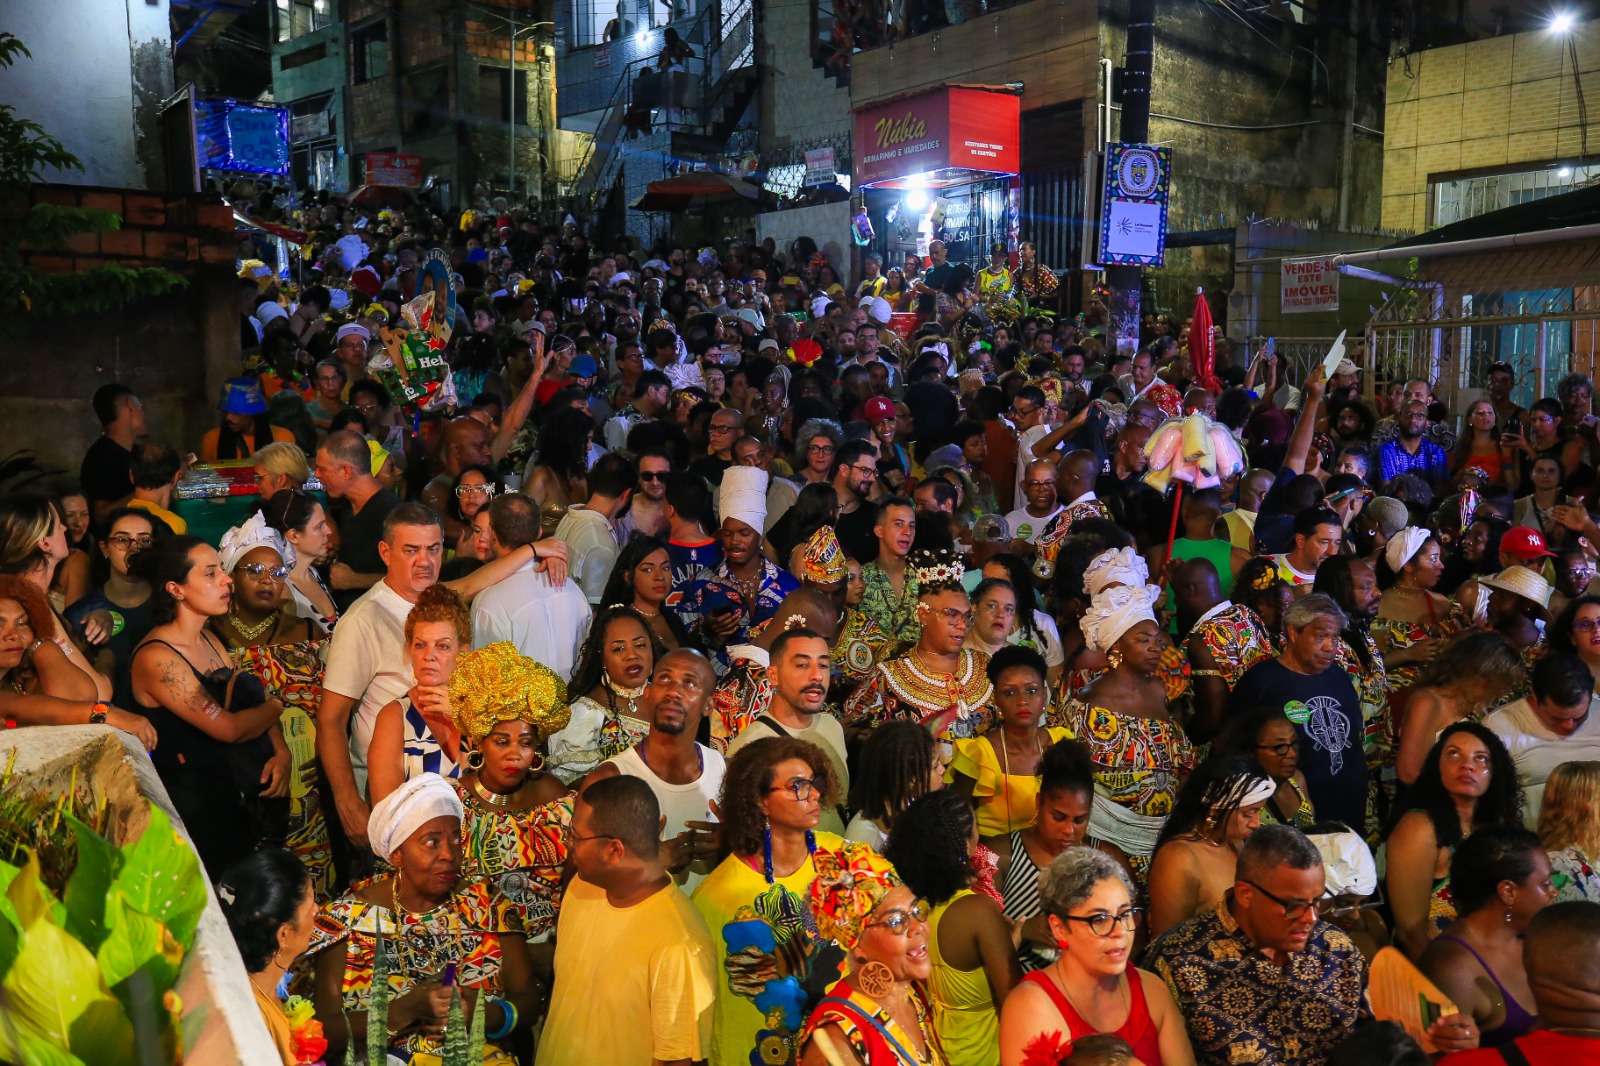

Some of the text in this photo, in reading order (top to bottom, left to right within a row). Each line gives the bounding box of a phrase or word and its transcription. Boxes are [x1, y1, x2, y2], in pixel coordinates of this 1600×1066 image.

[874, 111, 928, 149] Núbia
[863, 140, 940, 164] ARMARINHO E VARIEDADES
[1297, 274, 1322, 283] ESTE
[1284, 284, 1337, 298] IMÓVEL
